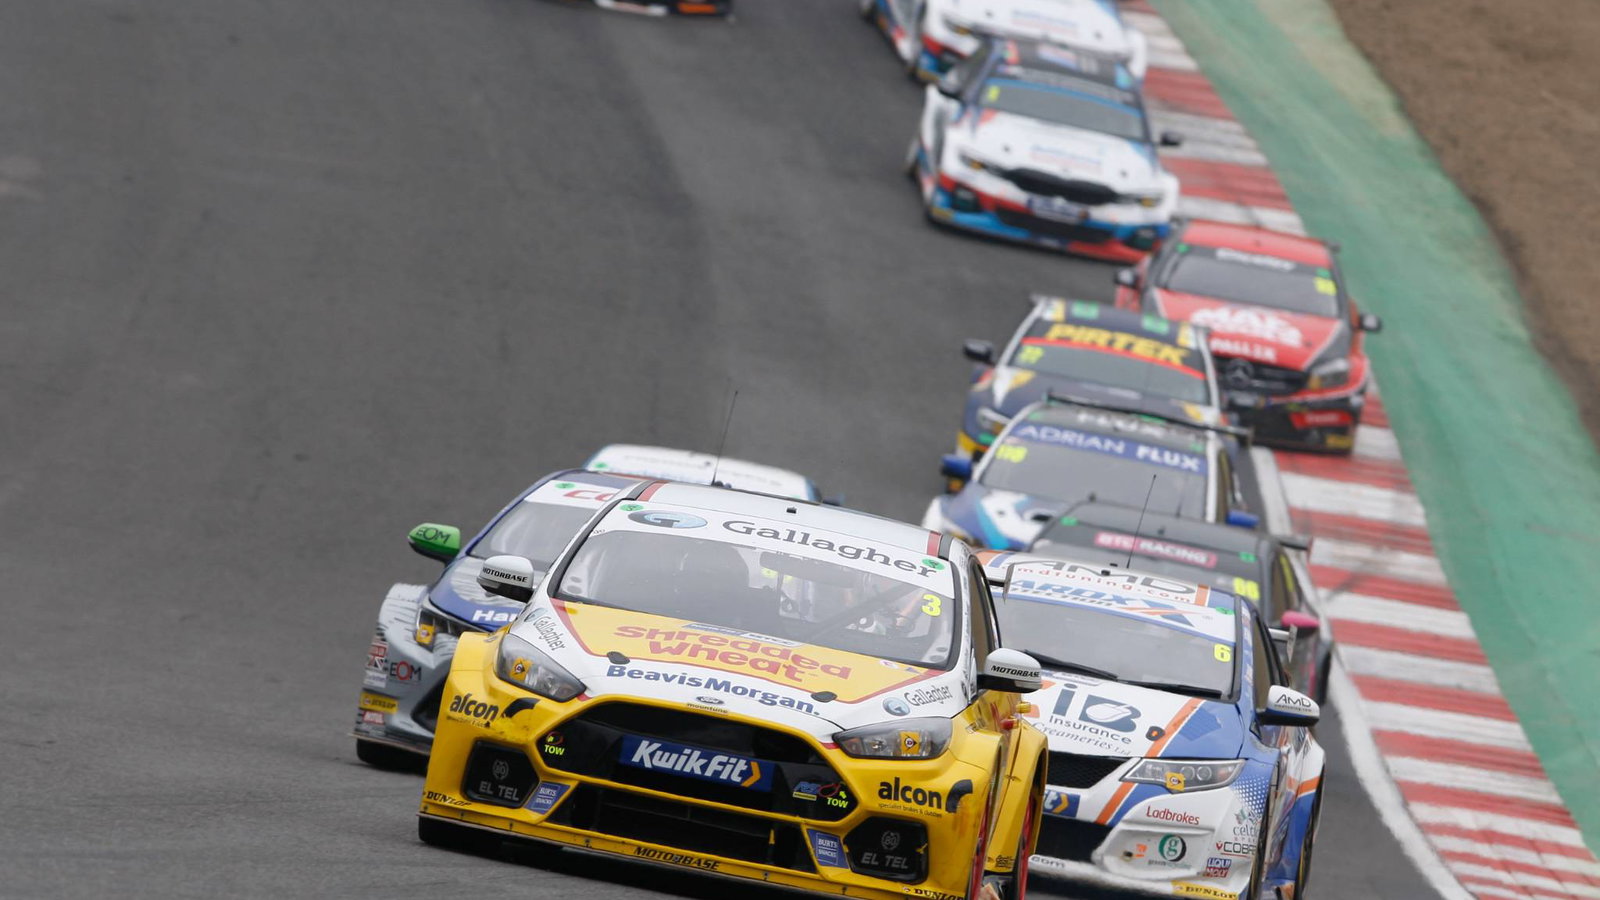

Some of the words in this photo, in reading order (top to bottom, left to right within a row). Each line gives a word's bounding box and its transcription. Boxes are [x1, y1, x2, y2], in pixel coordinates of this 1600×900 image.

[1046, 324, 1190, 366] PIRTEK
[1018, 425, 1125, 453] ADRIAN
[1137, 444, 1200, 472] FLUX
[416, 527, 452, 545] EOM
[722, 520, 937, 578] Gallagher
[1140, 540, 1208, 565] RACING
[482, 566, 528, 583] MOTORBASE
[1002, 565, 1190, 603] mdtuning.com
[921, 594, 941, 617] 3
[533, 616, 566, 651] Gallagher
[1214, 644, 1231, 663] 6
[389, 660, 423, 681] EOM
[991, 665, 1040, 678] MOTORBASE
[903, 685, 953, 706] Gallagher
[1276, 694, 1312, 708] AMD
[450, 693, 499, 722] alcon
[1032, 721, 1113, 750] Creameries
[1049, 715, 1132, 745] Insurance
[544, 744, 565, 756] TOW
[426, 791, 472, 807] DUNLOP
[479, 781, 494, 794] EL
[498, 785, 520, 801] TEL
[878, 776, 942, 809] alcon
[827, 797, 849, 808] TOW
[1146, 806, 1200, 826] Ladbrokes
[634, 846, 720, 871] MOTORBASE
[861, 852, 879, 865] EL
[885, 855, 909, 869] TEL
[1207, 858, 1231, 868] LIQUI
[1185, 886, 1237, 899] DUNLOP
